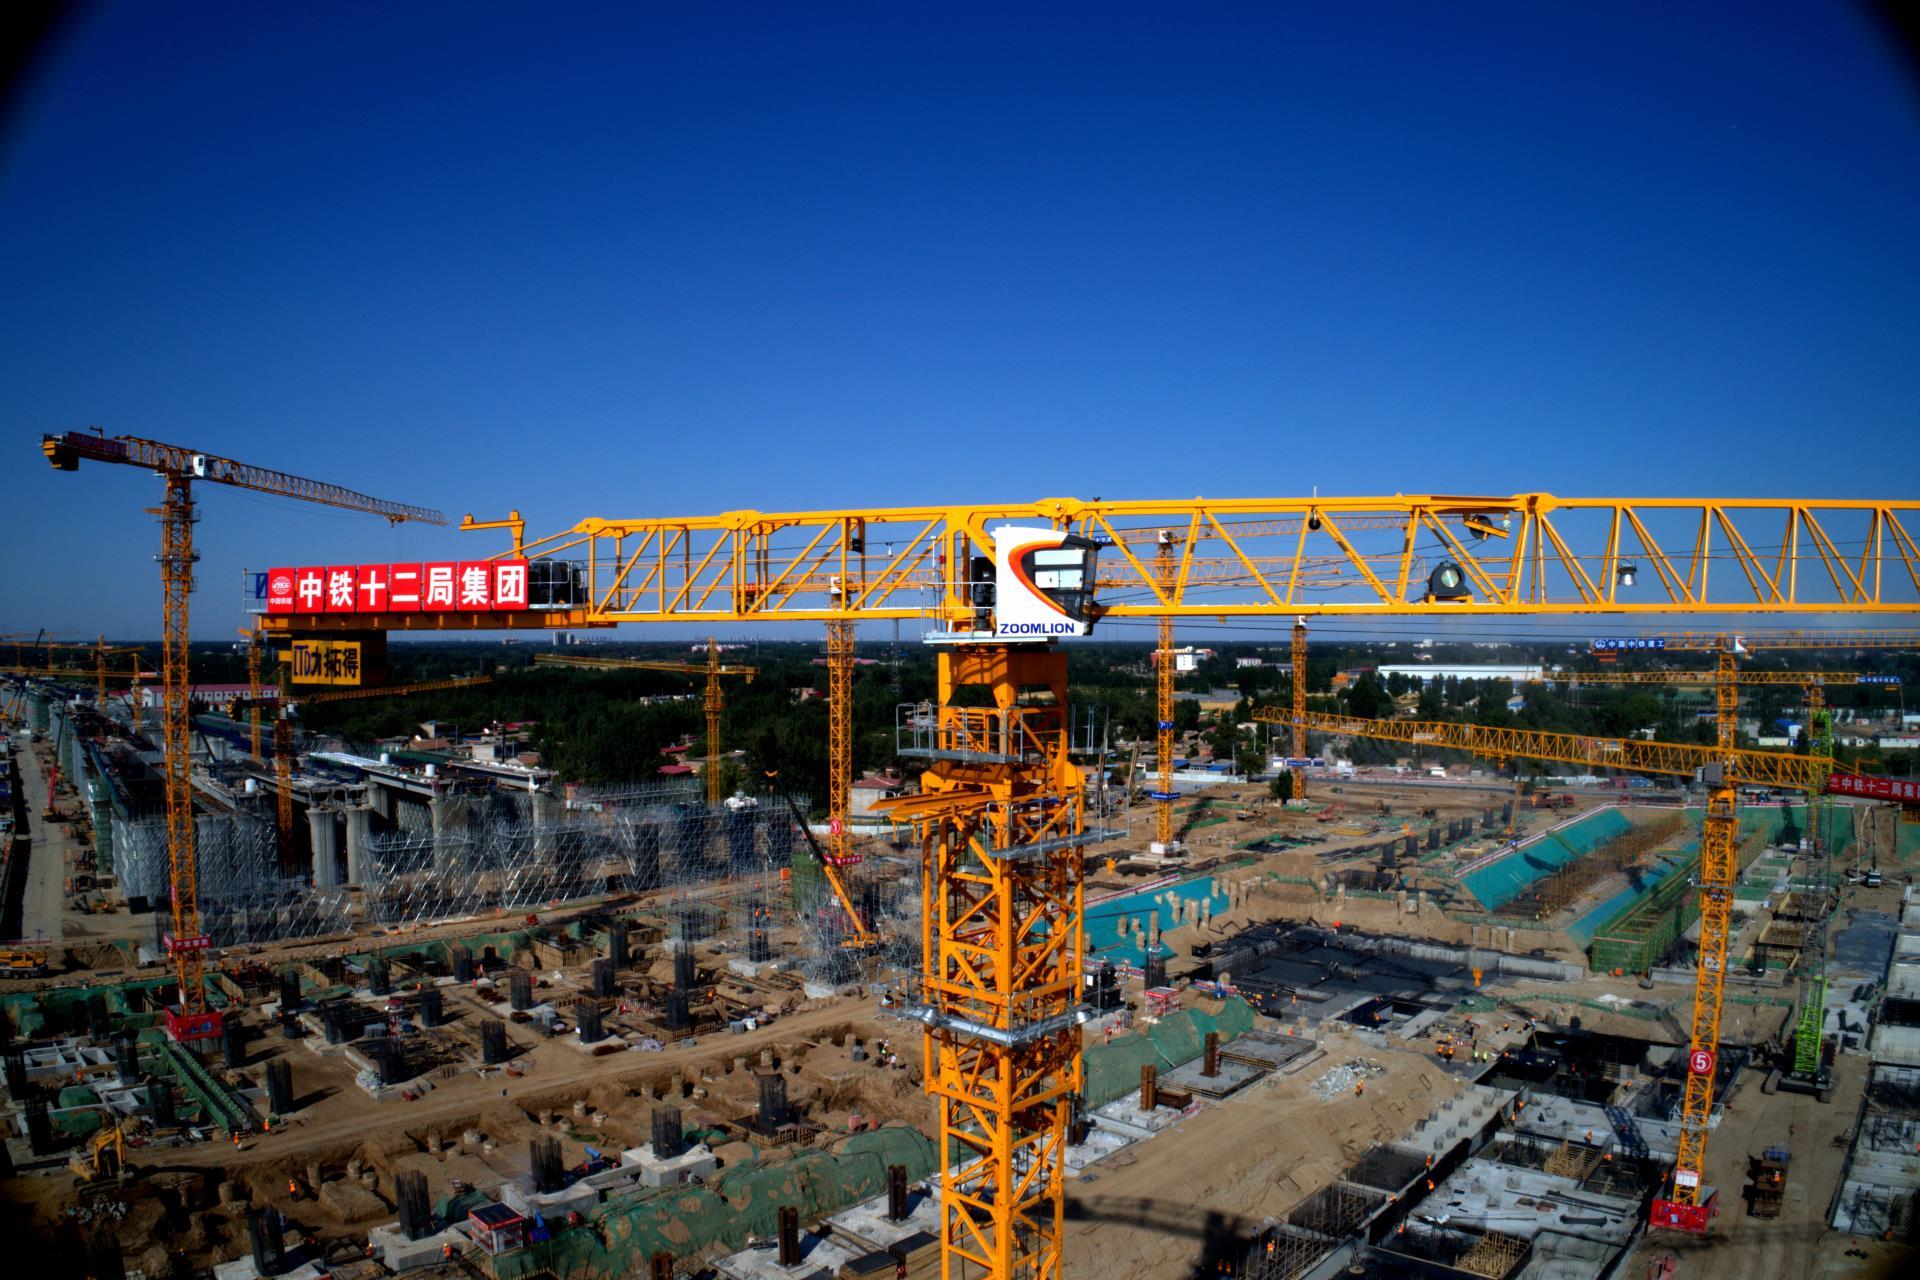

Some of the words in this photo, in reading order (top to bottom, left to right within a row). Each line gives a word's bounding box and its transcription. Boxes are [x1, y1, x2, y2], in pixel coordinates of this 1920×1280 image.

[299, 565, 525, 608] 中铁十二局集团
[1000, 623, 1075, 633] ZOOMLION
